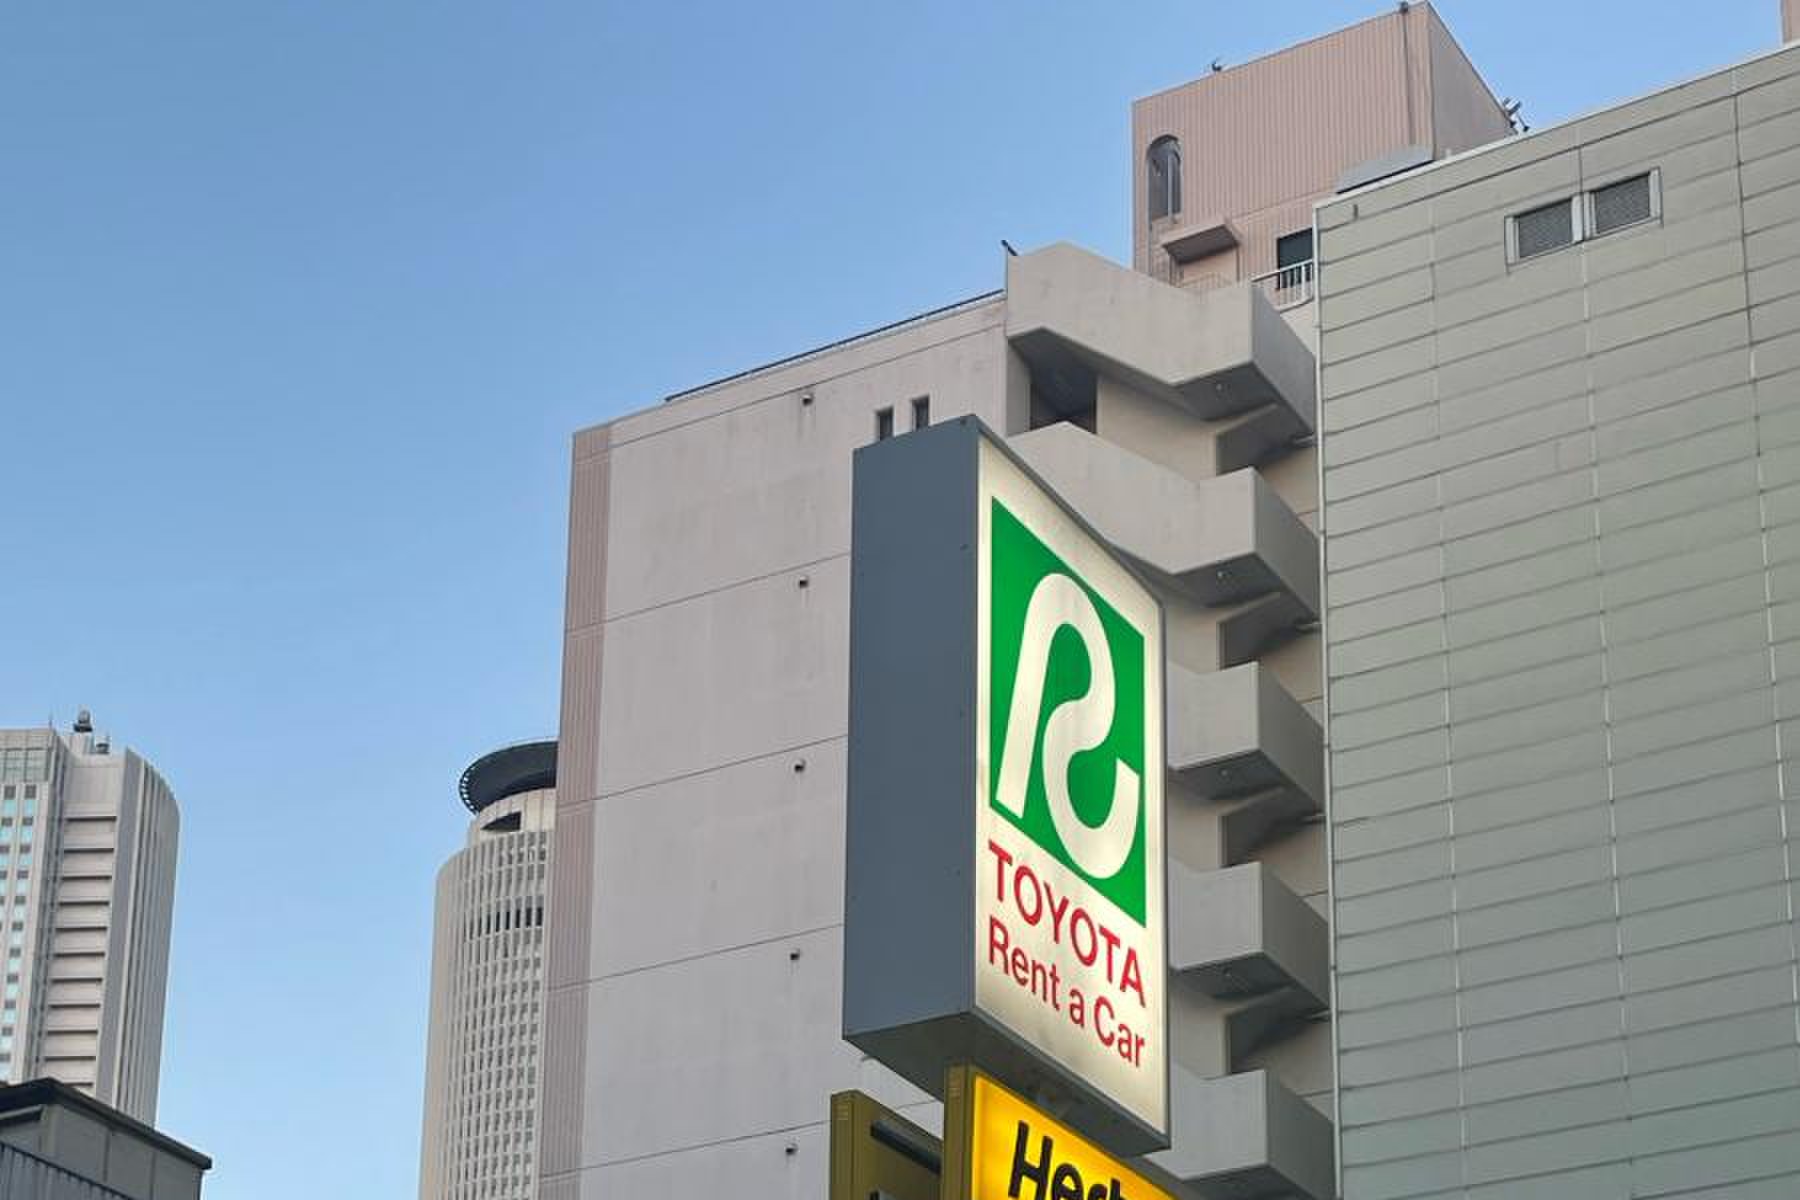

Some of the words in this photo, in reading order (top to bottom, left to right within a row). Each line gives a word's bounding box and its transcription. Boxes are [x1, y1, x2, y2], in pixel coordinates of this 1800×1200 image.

[989, 839, 1146, 1008] TOYOTA
[989, 914, 1061, 1011] Rent
[1069, 988, 1085, 1028] a
[1094, 996, 1145, 1067] Car
